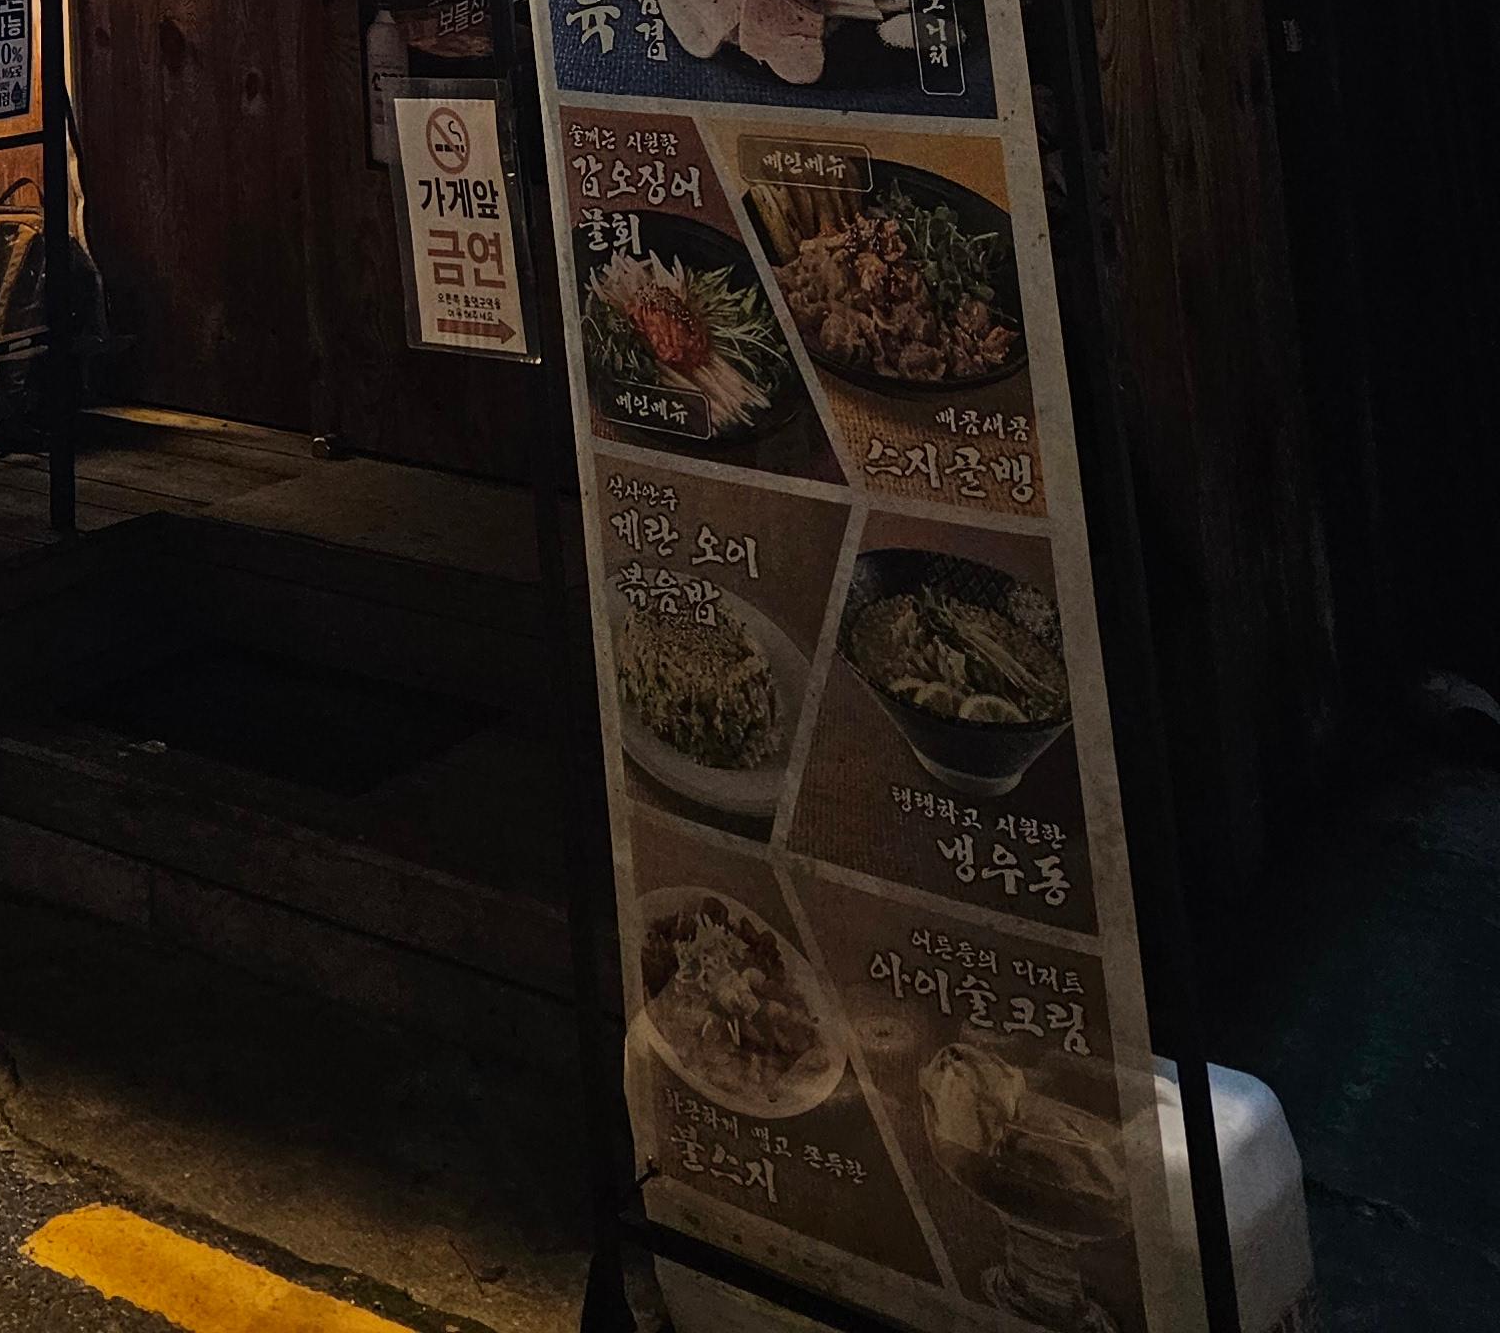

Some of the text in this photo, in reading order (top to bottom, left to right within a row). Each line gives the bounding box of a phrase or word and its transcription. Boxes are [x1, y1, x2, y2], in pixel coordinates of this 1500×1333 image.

[569, 124, 679, 156] 술깨는 시원함
[762, 149, 848, 180] 메인메뉴
[418, 176, 500, 220] 가게앞
[572, 154, 703, 208] 갑오징어
[579, 207, 642, 255] 물회
[427, 229, 507, 289] 금연
[615, 391, 689, 425] 메인메뉴
[935, 407, 1030, 442] 매콤새콤
[607, 475, 679, 512] 식사안주
[610, 508, 759, 579] 계란 오이
[617, 562, 722, 627] 볶음밥
[892, 786, 1067, 850] 탱탱하고 시원한
[937, 834, 1072, 906] 냉우동
[911, 929, 1084, 995] 어른들의 디저트
